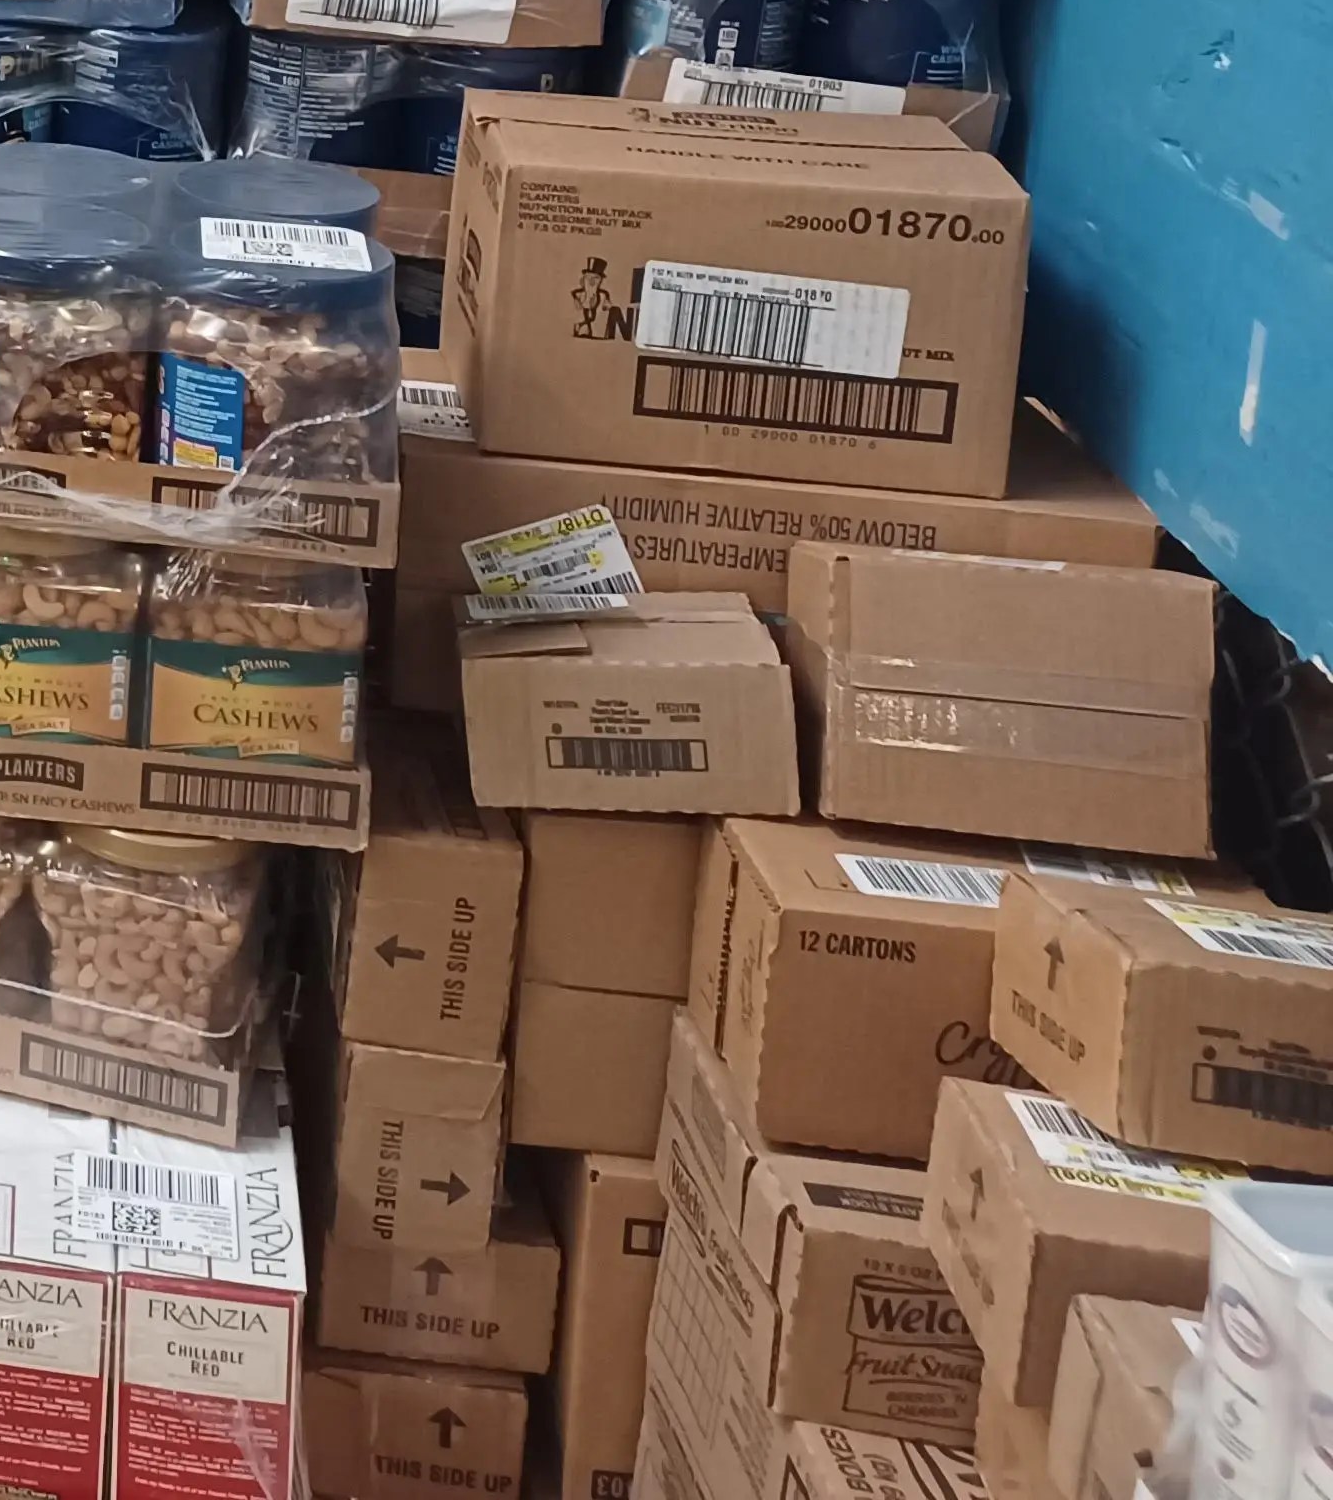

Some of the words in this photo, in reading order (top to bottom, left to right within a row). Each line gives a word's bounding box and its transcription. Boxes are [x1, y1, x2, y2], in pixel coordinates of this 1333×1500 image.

[627, 146, 724, 161] HANDLE
[733, 155, 794, 166] WITH
[802, 159, 869, 171] CARE
[520, 192, 580, 204] PLANTERS
[518, 211, 588, 227] WHOLESOME
[590, 216, 619, 228] NUT
[621, 219, 642, 229] MIX
[586, 208, 653, 220] MULTIPACK
[750, 429, 798, 443] 29000
[808, 435, 859, 449] 01870
[556, 508, 604, 536] D1187
[706, 503, 803, 536] RELATIVE
[809, 515, 851, 540] 50%
[858, 521, 937, 549] BELOW
[193, 703, 318, 733] CASHEWS
[11, 794, 30, 806] SN
[70, 798, 136, 816] CASHEWS
[453, 897, 477, 923] UP
[446, 929, 472, 973] SIDE
[799, 930, 821, 954] 12
[826, 933, 917, 965] CARTONS
[440, 978, 465, 1020] THIS
[1067, 1033, 1087, 1065] UP
[381, 1119, 404, 1158] THIS
[378, 1163, 397, 1208] SIDE
[246, 1166, 294, 1280] FRANZIA
[373, 1211, 394, 1240] UP
[147, 1298, 268, 1334] FRANZIA
[360, 1306, 408, 1330] THIS
[415, 1311, 464, 1334] SIDE
[471, 1319, 501, 1341] UP
[6, 1333, 36, 1351] RED
[167, 1341, 245, 1365] CHILLABLE
[190, 1359, 222, 1379] RED
[845, 1351, 916, 1376] Fruit
[375, 1455, 420, 1478] THIS
[428, 1462, 478, 1489] SIDE
[483, 1471, 513, 1492] UP
